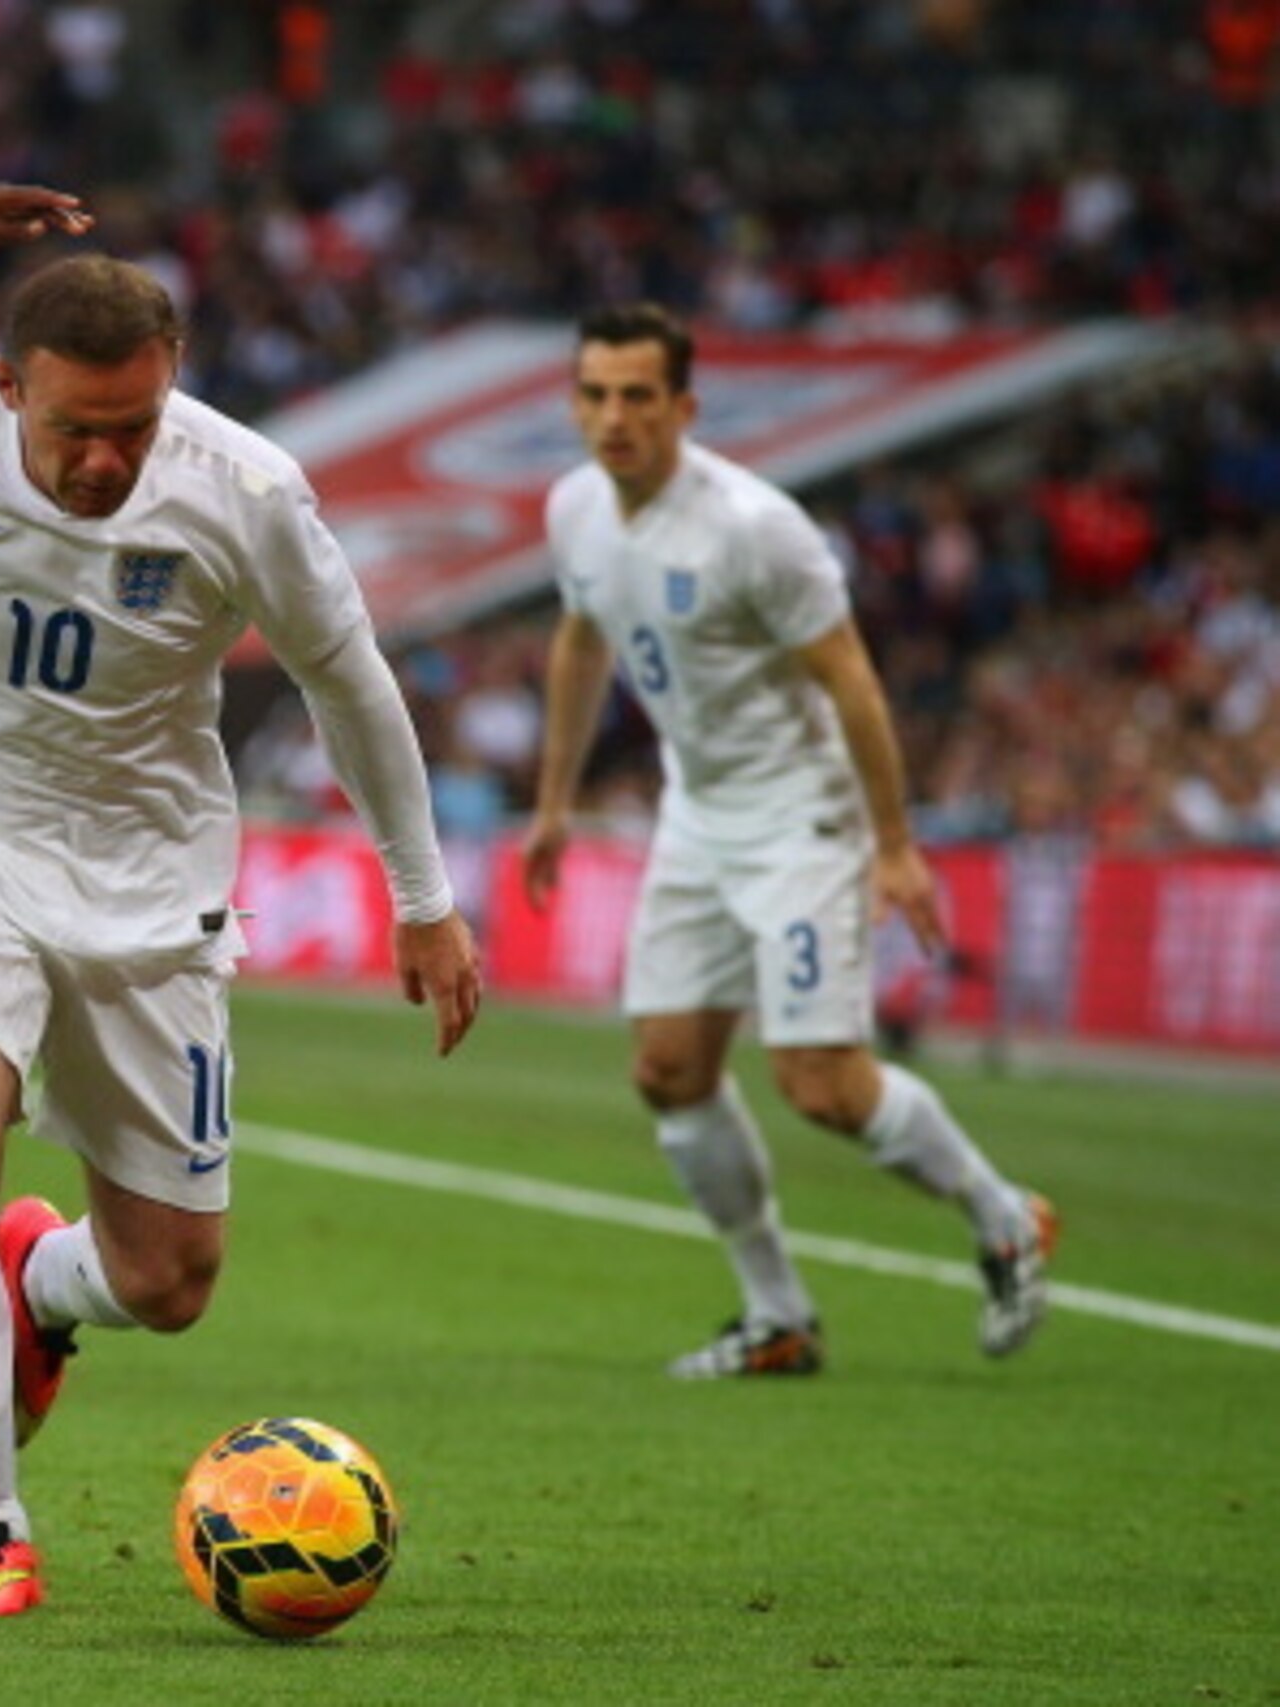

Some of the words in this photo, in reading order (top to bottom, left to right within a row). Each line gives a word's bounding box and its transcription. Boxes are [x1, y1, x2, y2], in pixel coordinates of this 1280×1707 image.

[8, 599, 95, 693] 10
[631, 628, 670, 693] 3
[786, 922, 821, 990] 3
